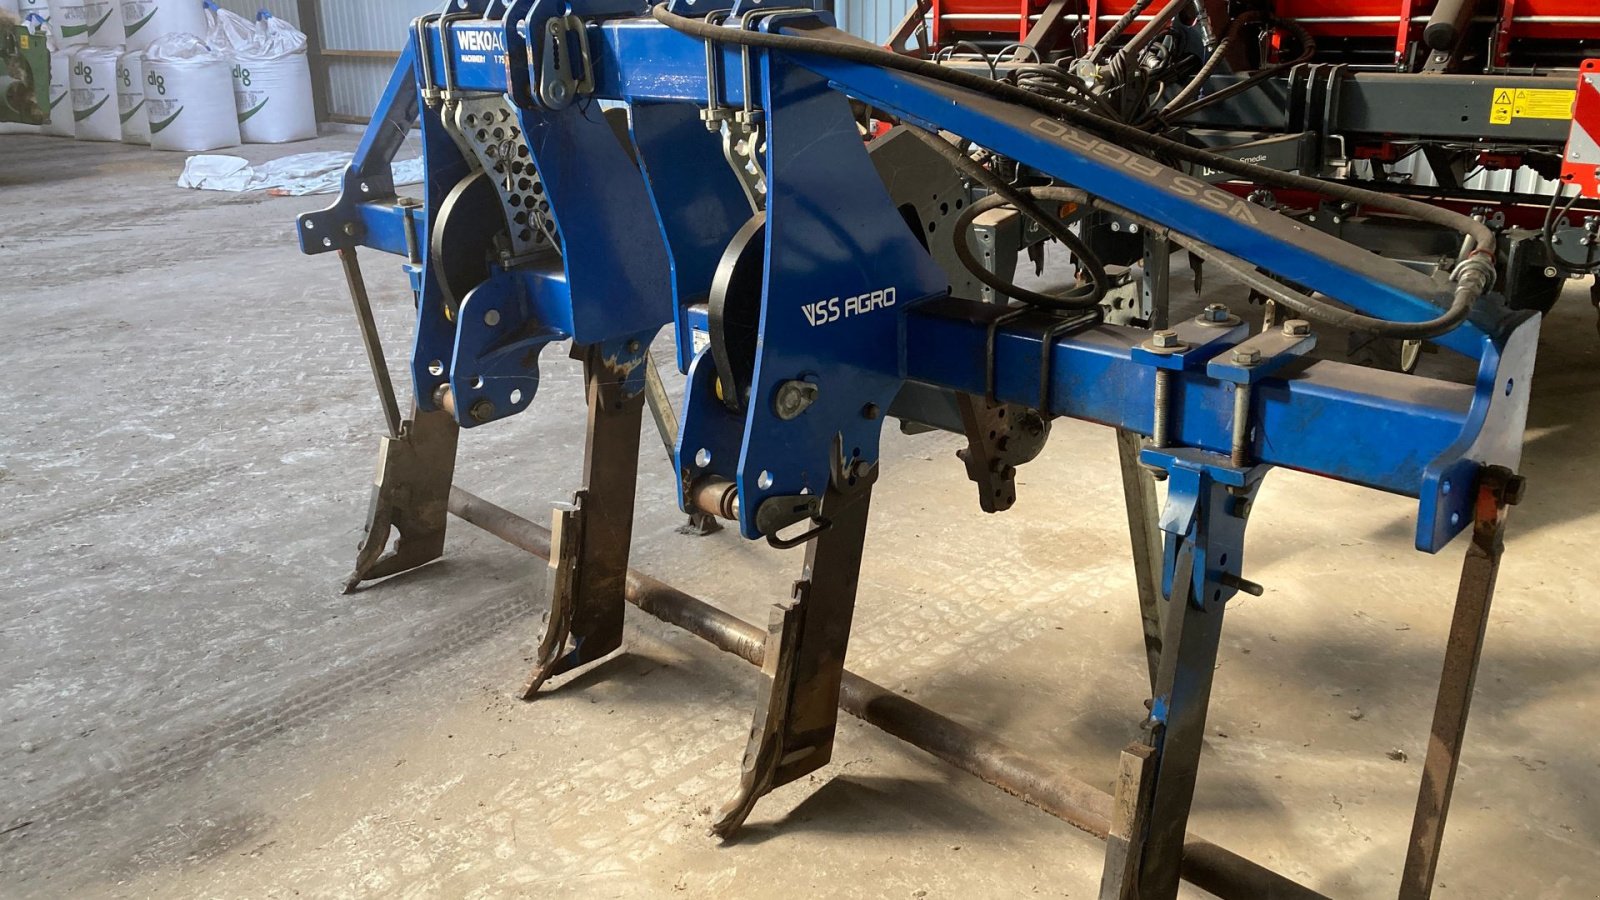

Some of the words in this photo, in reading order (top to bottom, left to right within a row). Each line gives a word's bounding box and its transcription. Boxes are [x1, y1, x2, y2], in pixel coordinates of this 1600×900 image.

[74, 61, 93, 84] dlg
[147, 70, 166, 95] dlg
[232, 64, 251, 87] dlg
[1030, 117, 1164, 177] AGRO
[1169, 176, 1258, 225] VSS
[801, 296, 840, 327] VSS
[844, 286, 896, 318] AGRO
